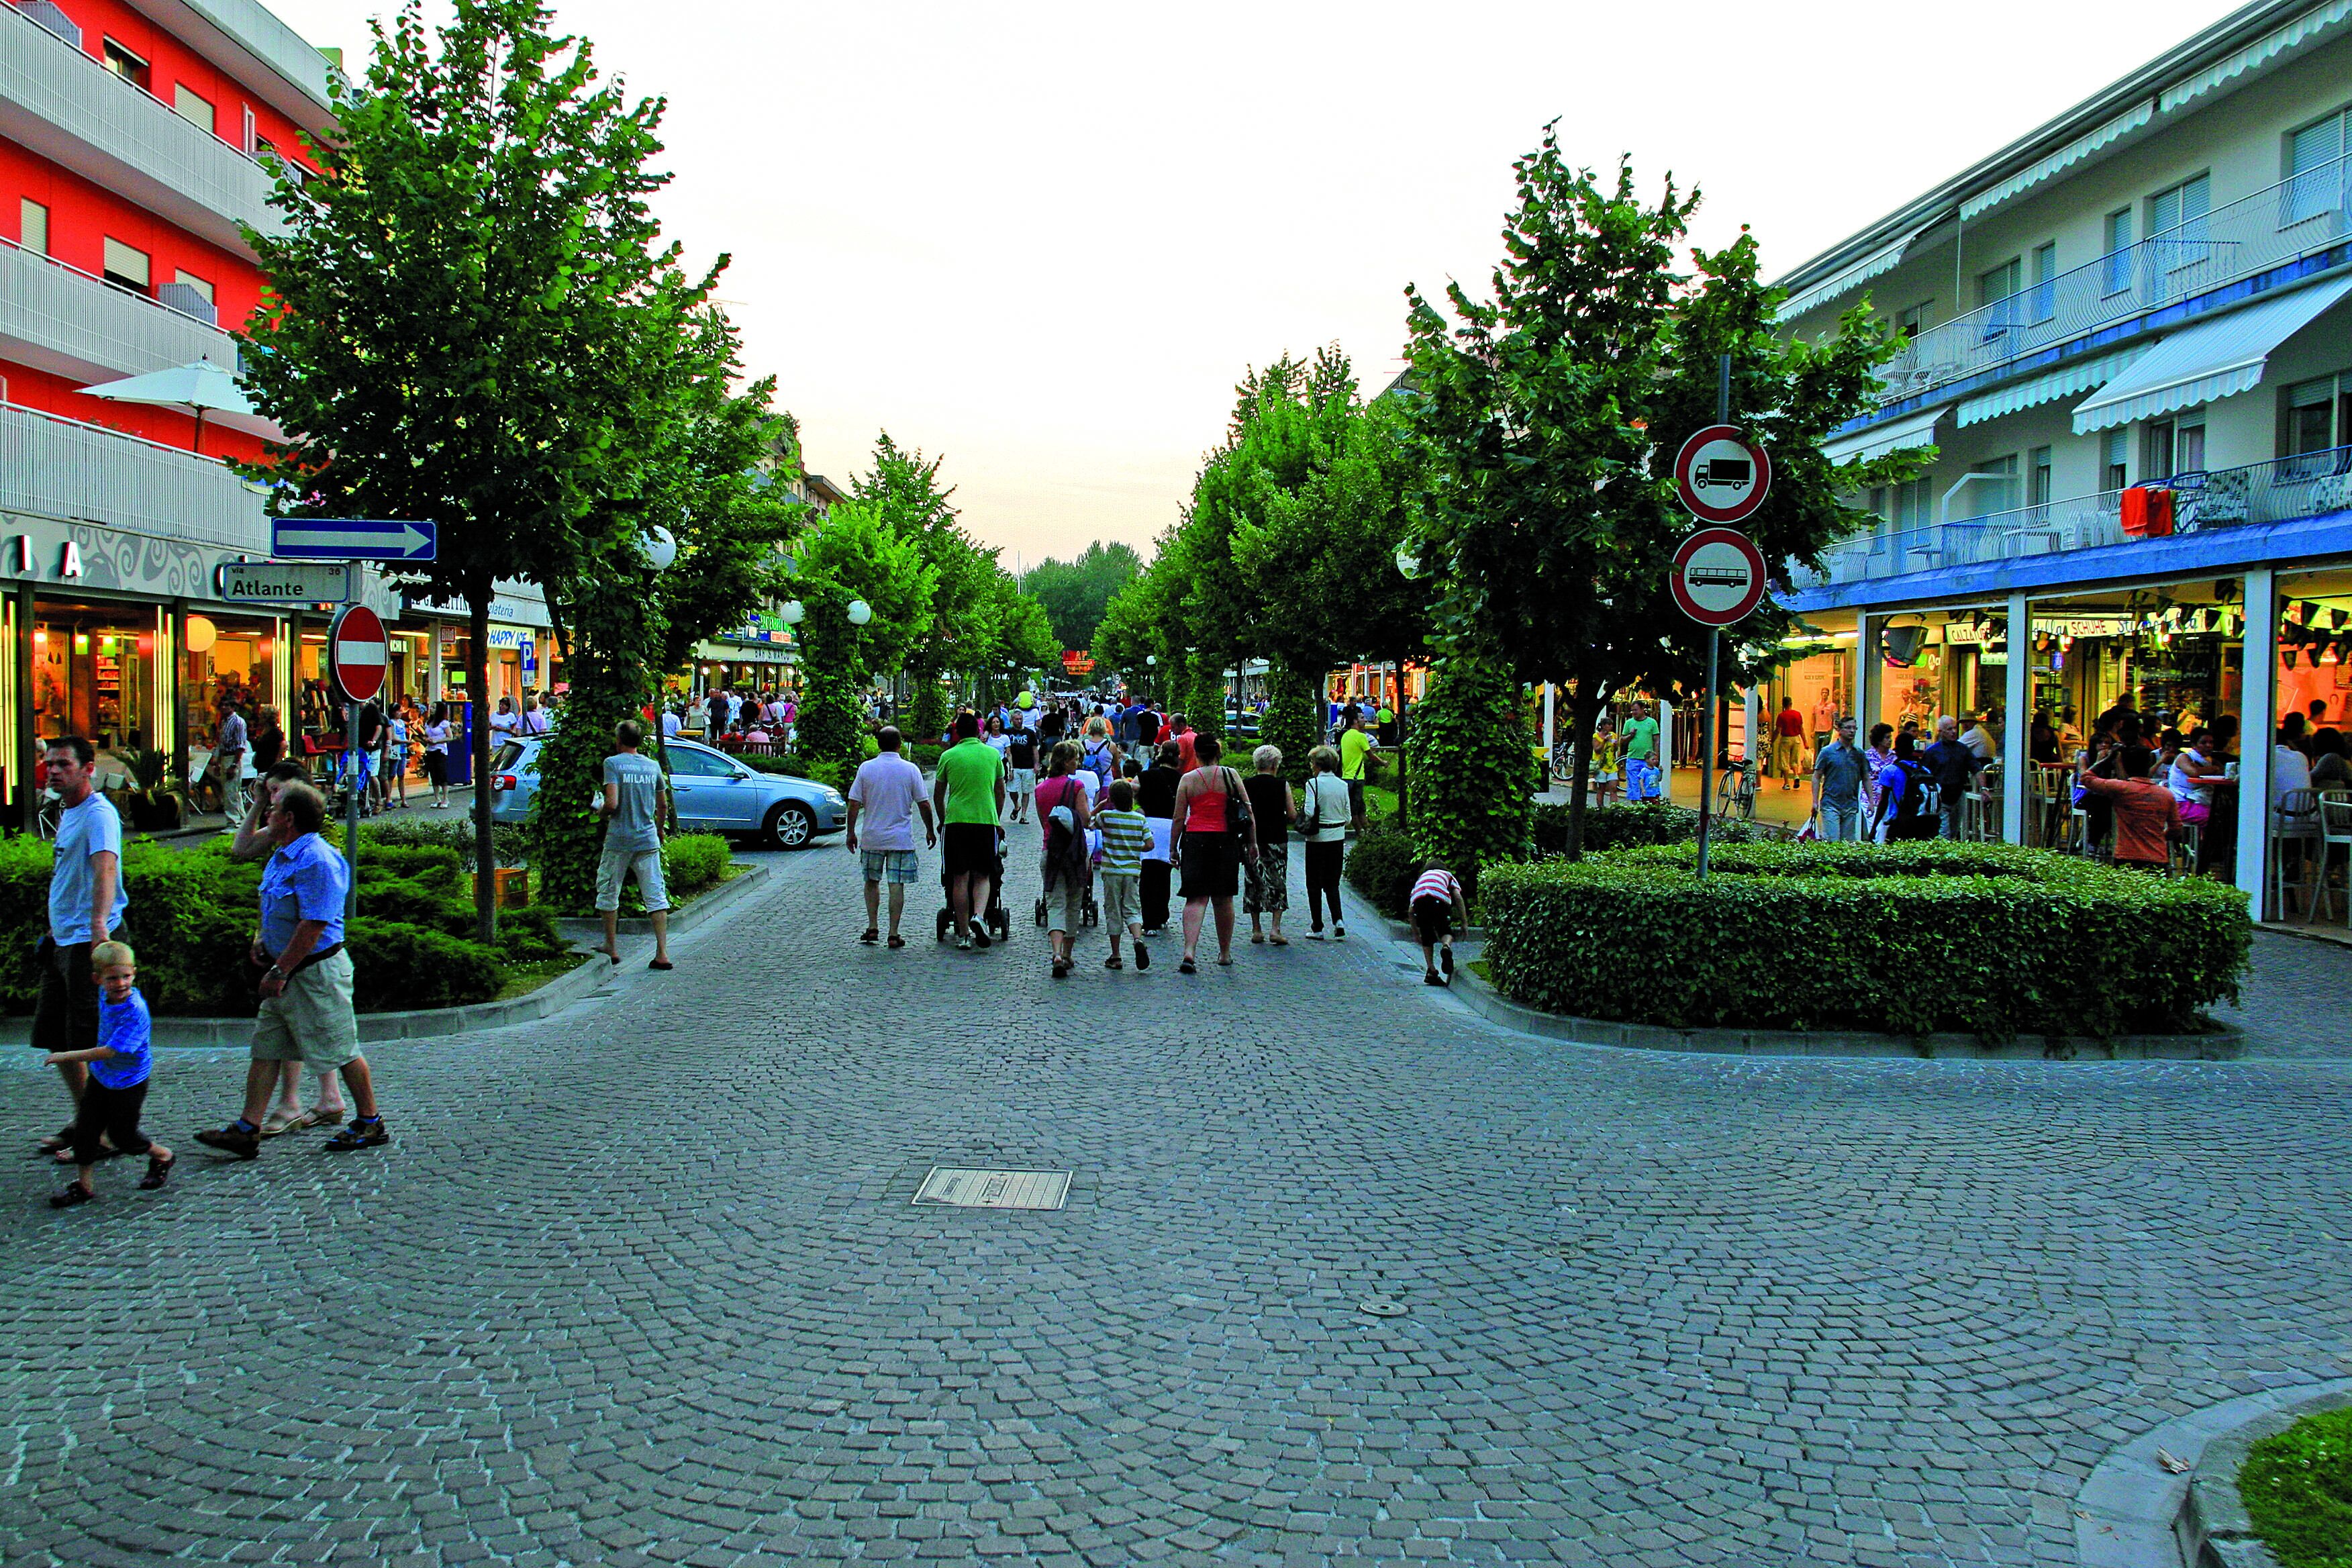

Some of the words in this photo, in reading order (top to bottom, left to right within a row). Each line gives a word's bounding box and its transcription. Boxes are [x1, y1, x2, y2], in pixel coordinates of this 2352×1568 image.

[232, 579, 303, 596] Atlante
[488, 603, 513, 618] elateria
[2071, 620, 2106, 636] SCHUHE
[489, 629, 516, 646] HAPPY
[524, 644, 532, 669] P
[622, 773, 656, 784] MILANO
